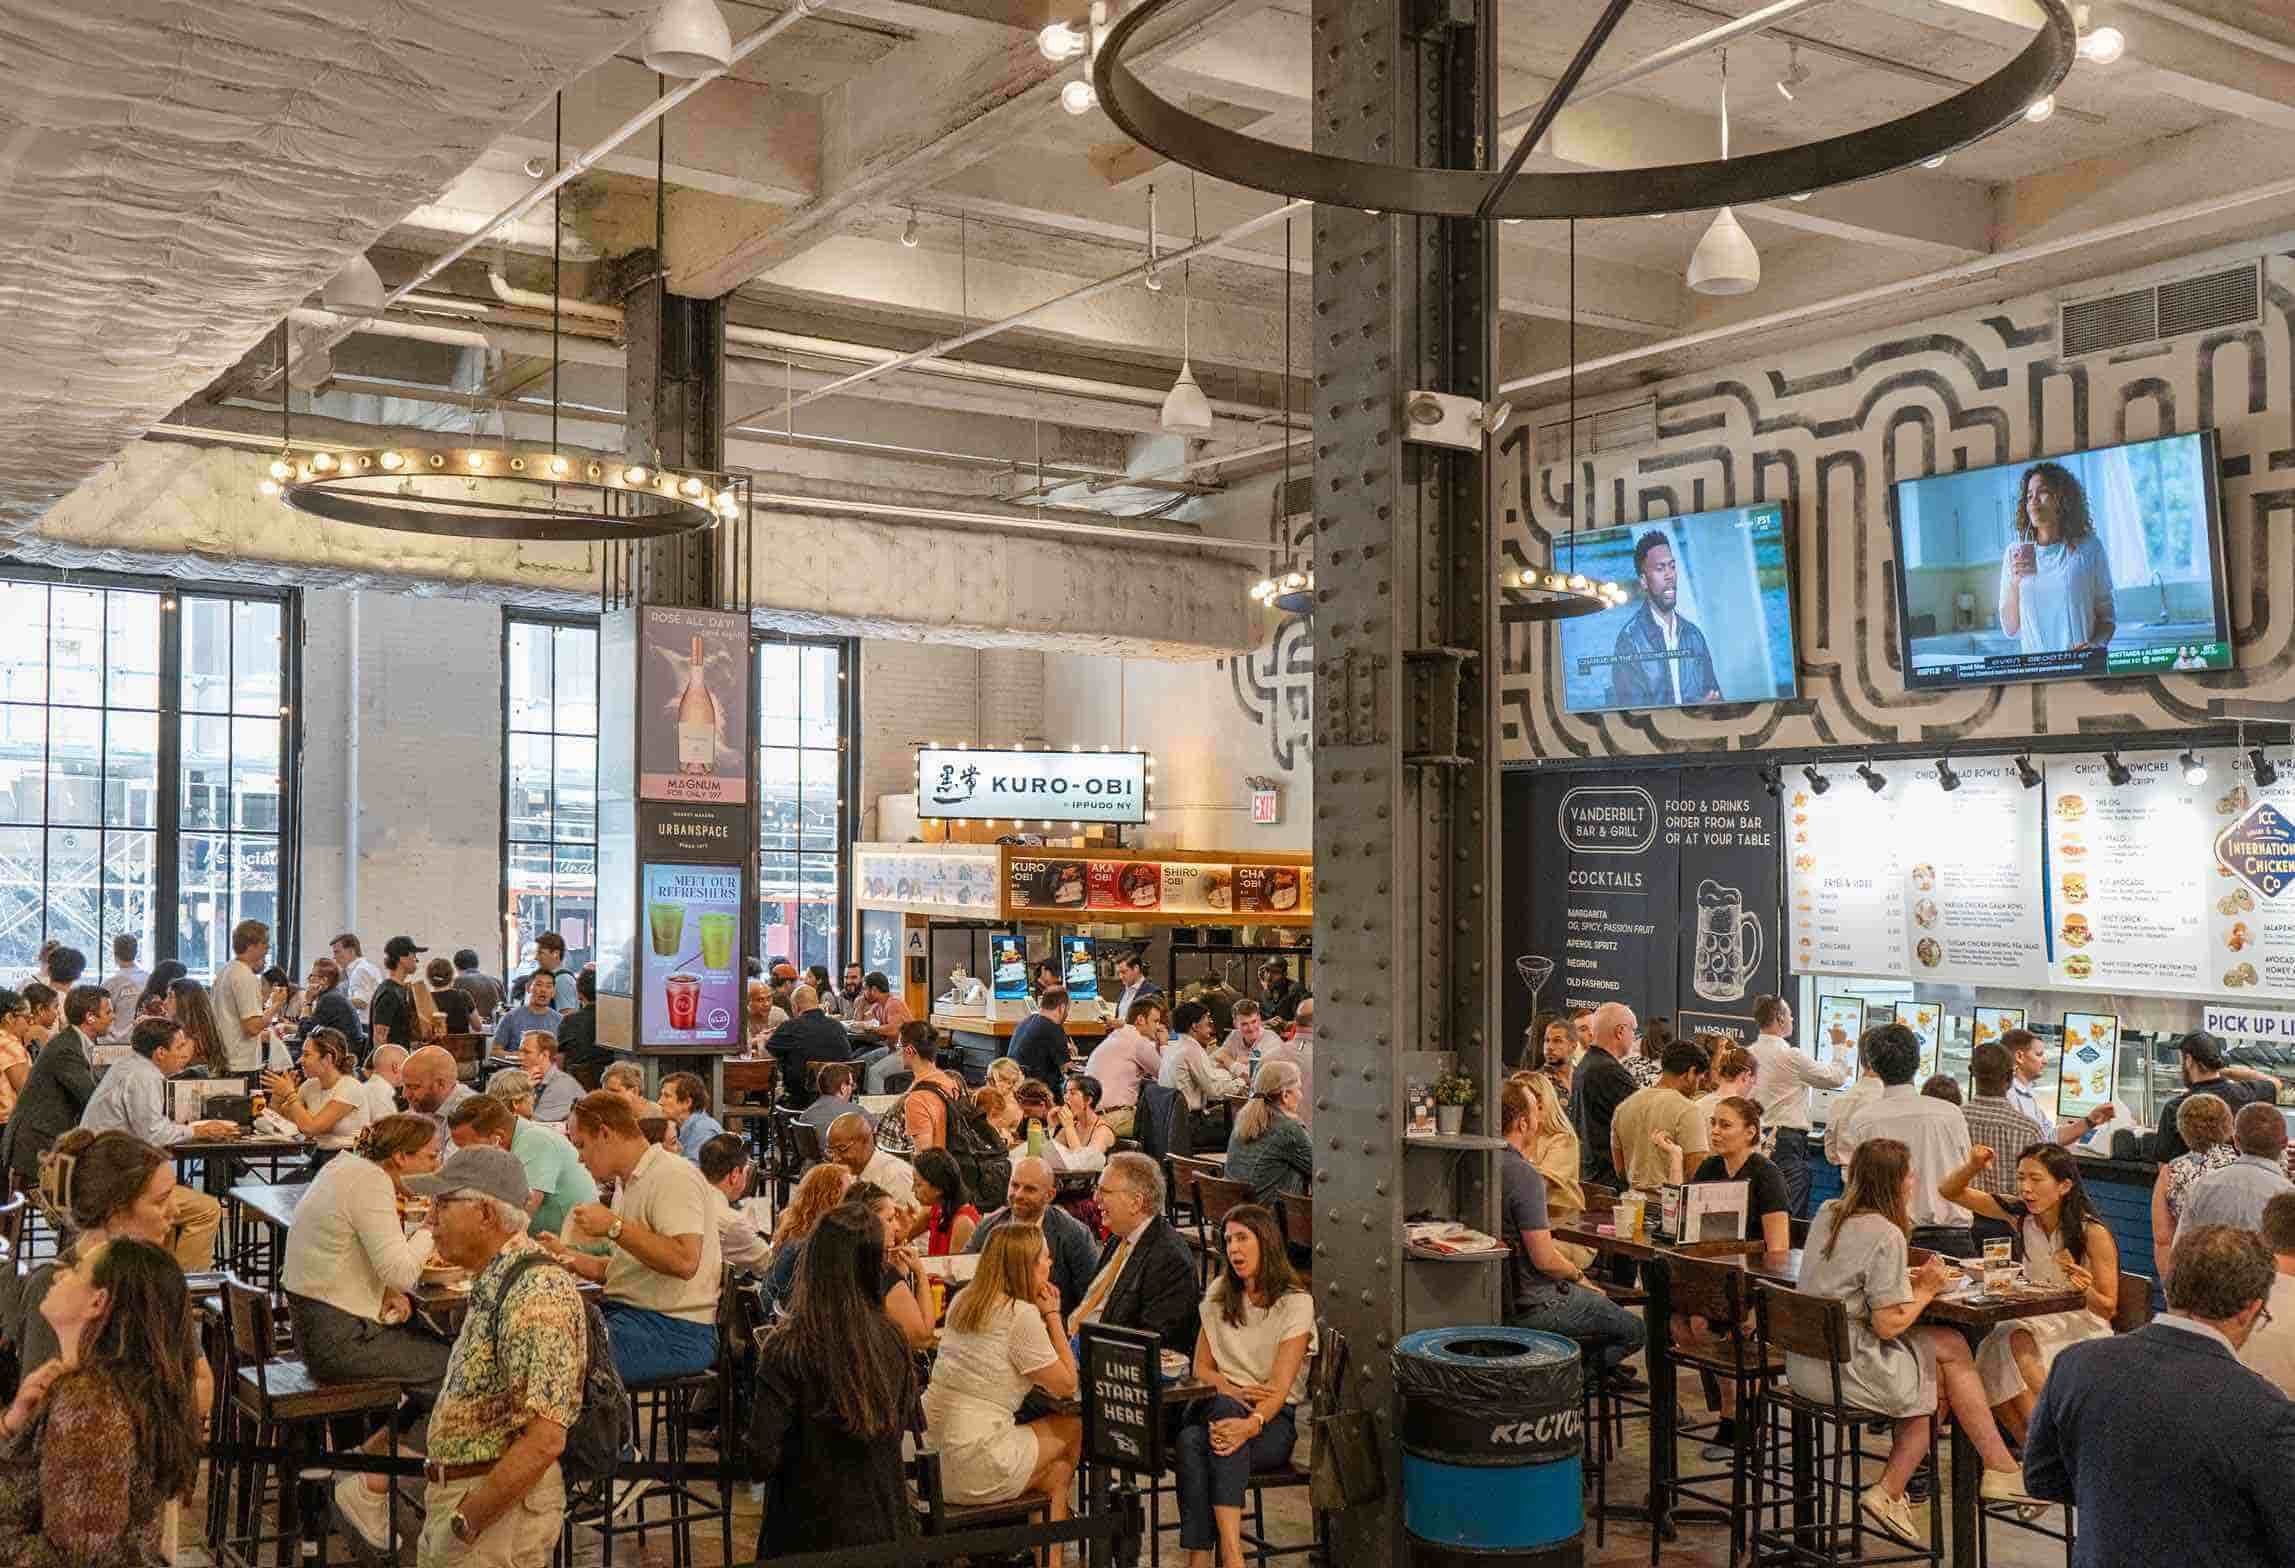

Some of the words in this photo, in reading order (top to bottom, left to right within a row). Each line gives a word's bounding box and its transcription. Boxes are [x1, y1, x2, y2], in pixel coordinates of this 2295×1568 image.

[1916, 769, 1938, 779] CHICK
[667, 779, 721, 791] MAGNUM
[992, 776, 1132, 795] KURO-OBI
[1072, 801, 1113, 809] IPPUDO
[1254, 795, 1274, 820] EXIT
[1665, 800, 1696, 812] FOOD
[1700, 800, 1708, 812] &
[1712, 800, 1750, 812] DRINKS
[1571, 807, 1645, 821] VANDERBILT
[2258, 811, 2277, 824] ICC
[1665, 816, 1700, 828] ORDER
[1705, 817, 1735, 829] FROM
[1740, 816, 1762, 829] BAR
[658, 823, 728, 838] URBANSPACE
[1576, 825, 1595, 837] BAR
[1599, 826, 1606, 837] &
[1610, 825, 1638, 837] GRILL
[1665, 833, 1681, 844] OR
[1686, 833, 1699, 844] AT
[1704, 833, 1733, 845] YOUR
[1737, 834, 1770, 846] TABLE
[1011, 862, 1046, 873] KURO
[1091, 863, 1114, 873] AKA
[1164, 867, 1199, 877] SHIRO
[1240, 868, 1265, 879] CHA
[673, 875, 705, 887] MEET
[711, 876, 736, 888] OUR
[1568, 870, 1643, 887] COCKTAILS
[659, 887, 736, 900] REFRESHERS
[1603, 923, 1632, 933] PASSION
[1634, 925, 1656, 935] FRUIT
[910, 931, 921, 948] A
[1566, 977, 1580, 986] OLD
[1582, 978, 1620, 990] FASHIONED
[2209, 1014, 2248, 1032] PICK
[2254, 1016, 2275, 1034] UP
[1105, 1360, 1140, 1383] LINE
[1096, 1379, 1149, 1405] STARTS
[1104, 1403, 1145, 1427] HERE
